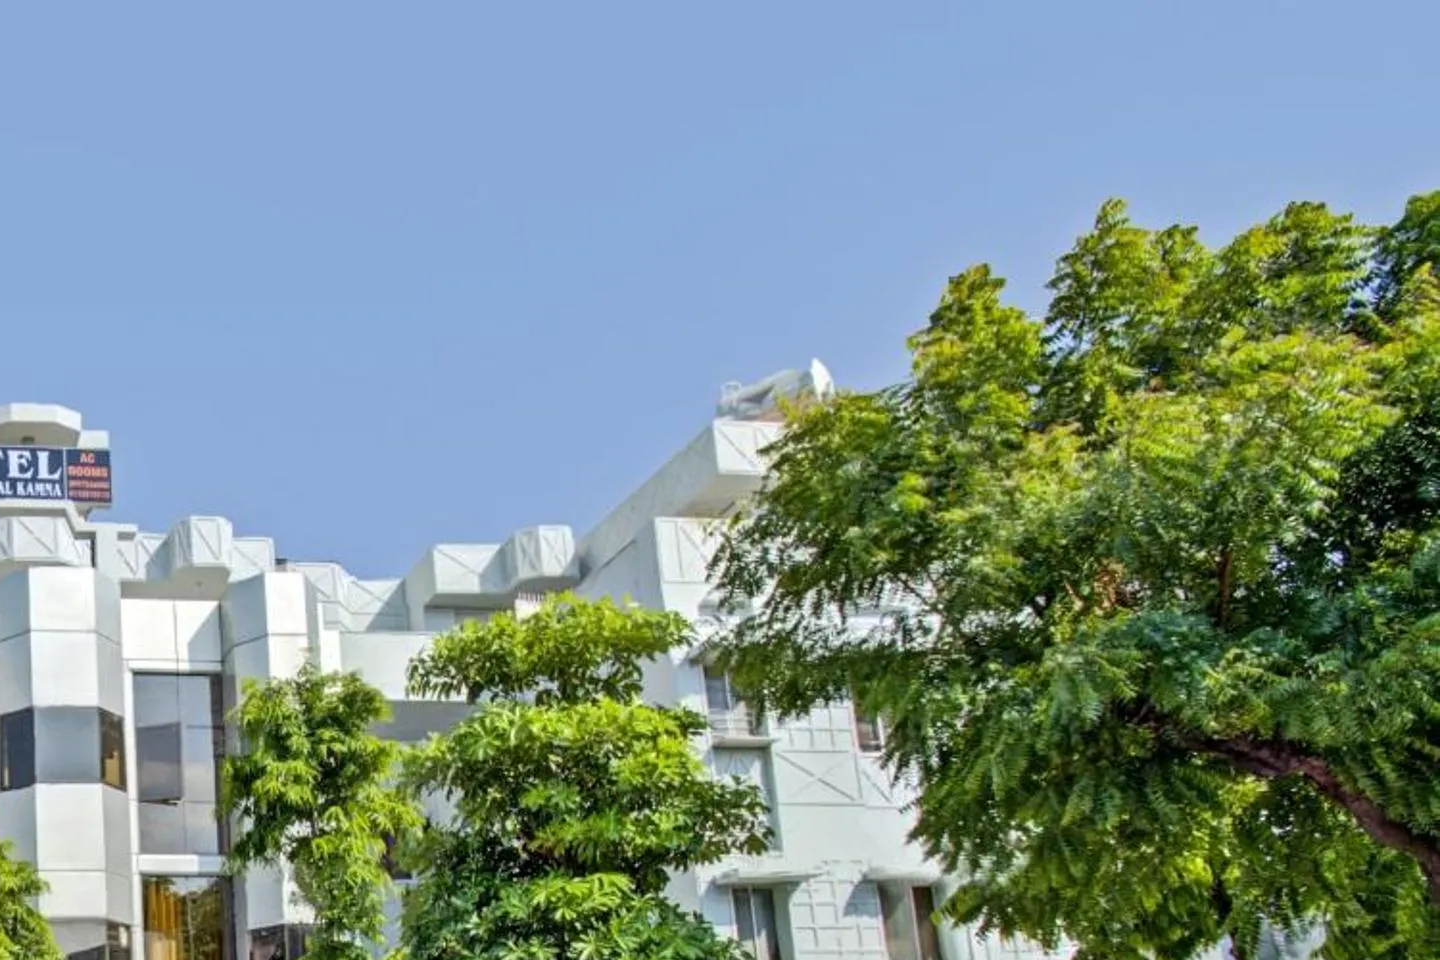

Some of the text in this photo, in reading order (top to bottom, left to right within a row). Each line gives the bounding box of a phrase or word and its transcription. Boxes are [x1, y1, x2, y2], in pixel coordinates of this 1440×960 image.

[80, 452, 95, 464] AC
[68, 466, 108, 478] ROOMS
[16, 481, 62, 497] KAMNA
